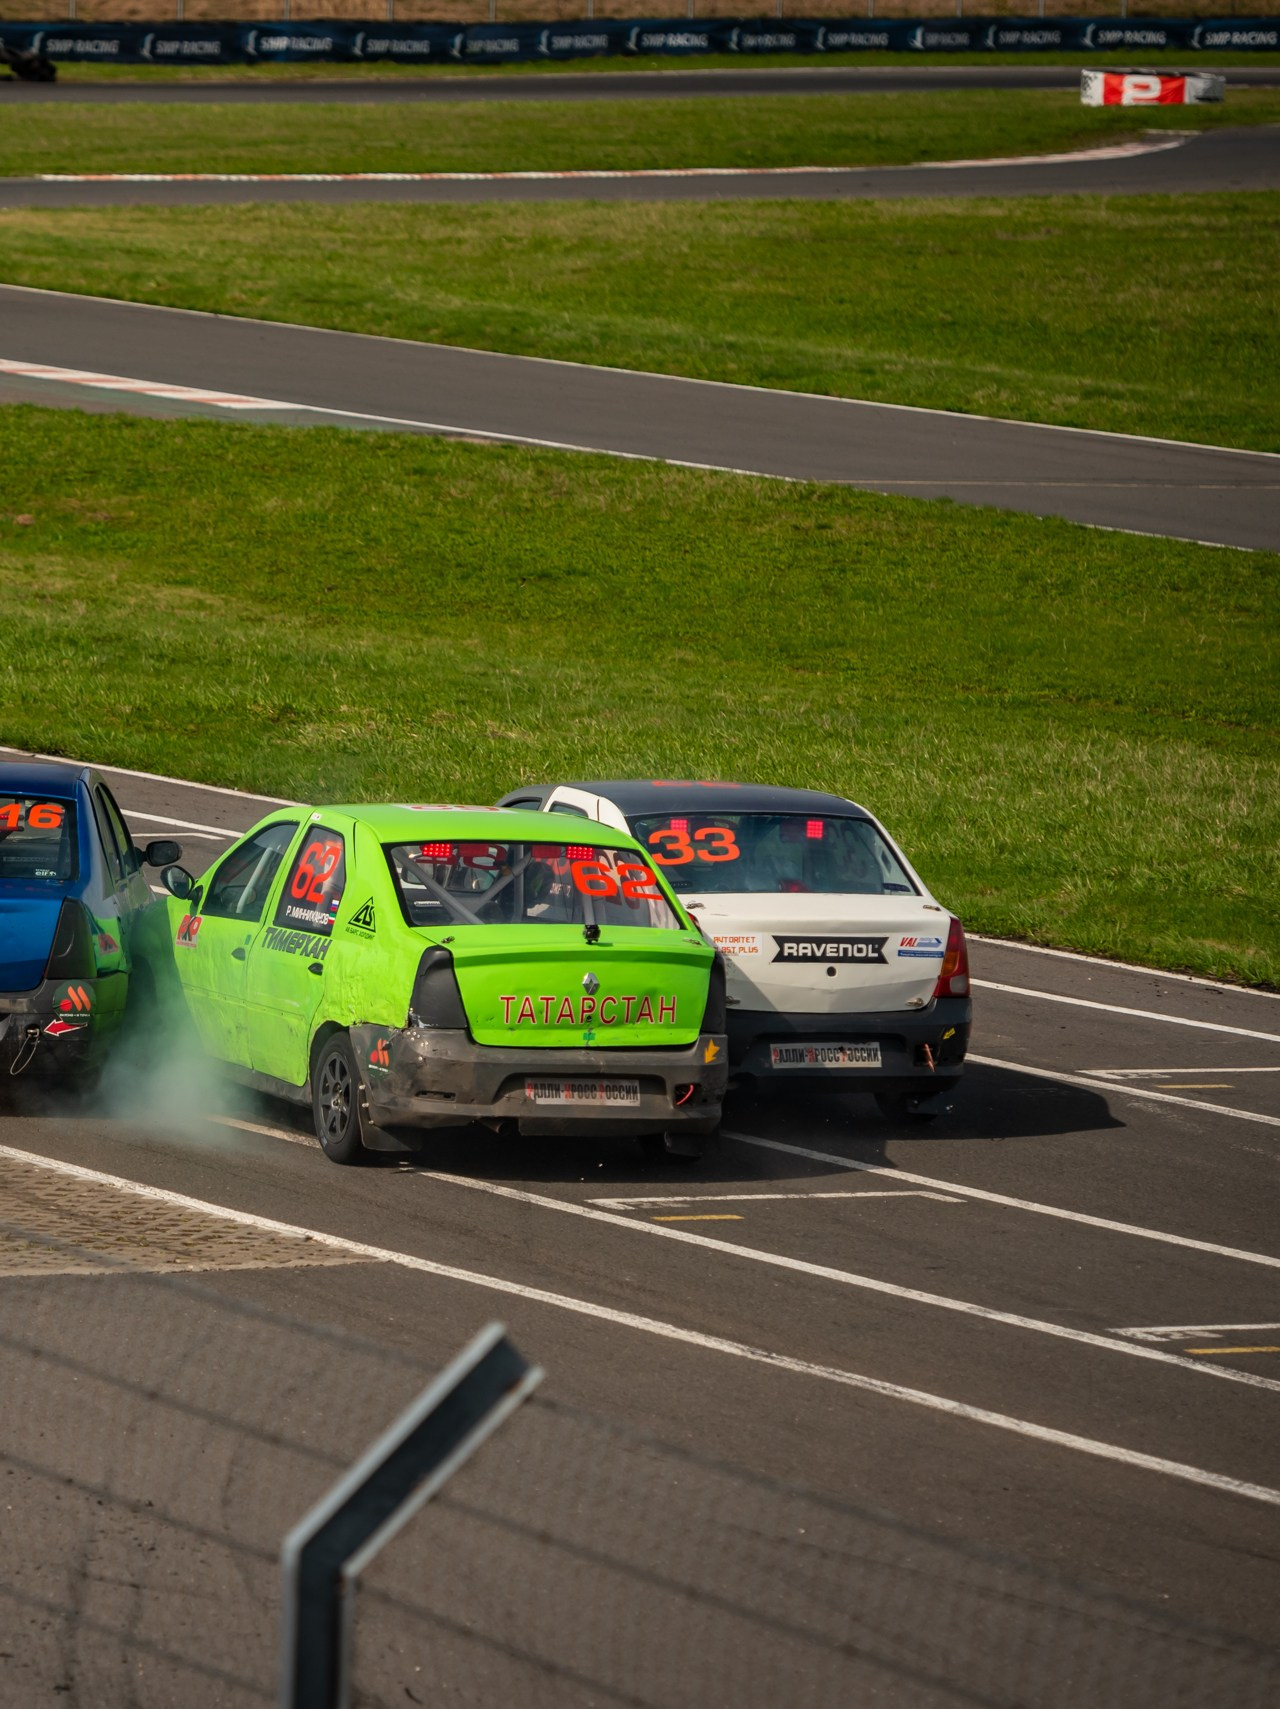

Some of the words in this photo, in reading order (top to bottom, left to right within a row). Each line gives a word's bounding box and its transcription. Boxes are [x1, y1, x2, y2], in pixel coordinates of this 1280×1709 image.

[1098, 30, 1122, 44] SMP
[1123, 30, 1167, 45] RACING
[1205, 31, 1231, 45] SMP
[1232, 31, 1278, 45] RACING
[648, 827, 740, 866] 33
[291, 841, 341, 903] 62
[571, 860, 663, 900] 62
[261, 926, 333, 960] ТИМЕРХАН
[738, 946, 759, 954] PLUS
[783, 942, 879, 958] RAVENOL
[499, 996, 677, 1024] ТАТАРСТАН
[598, 1083, 639, 1100] РОССИИ
